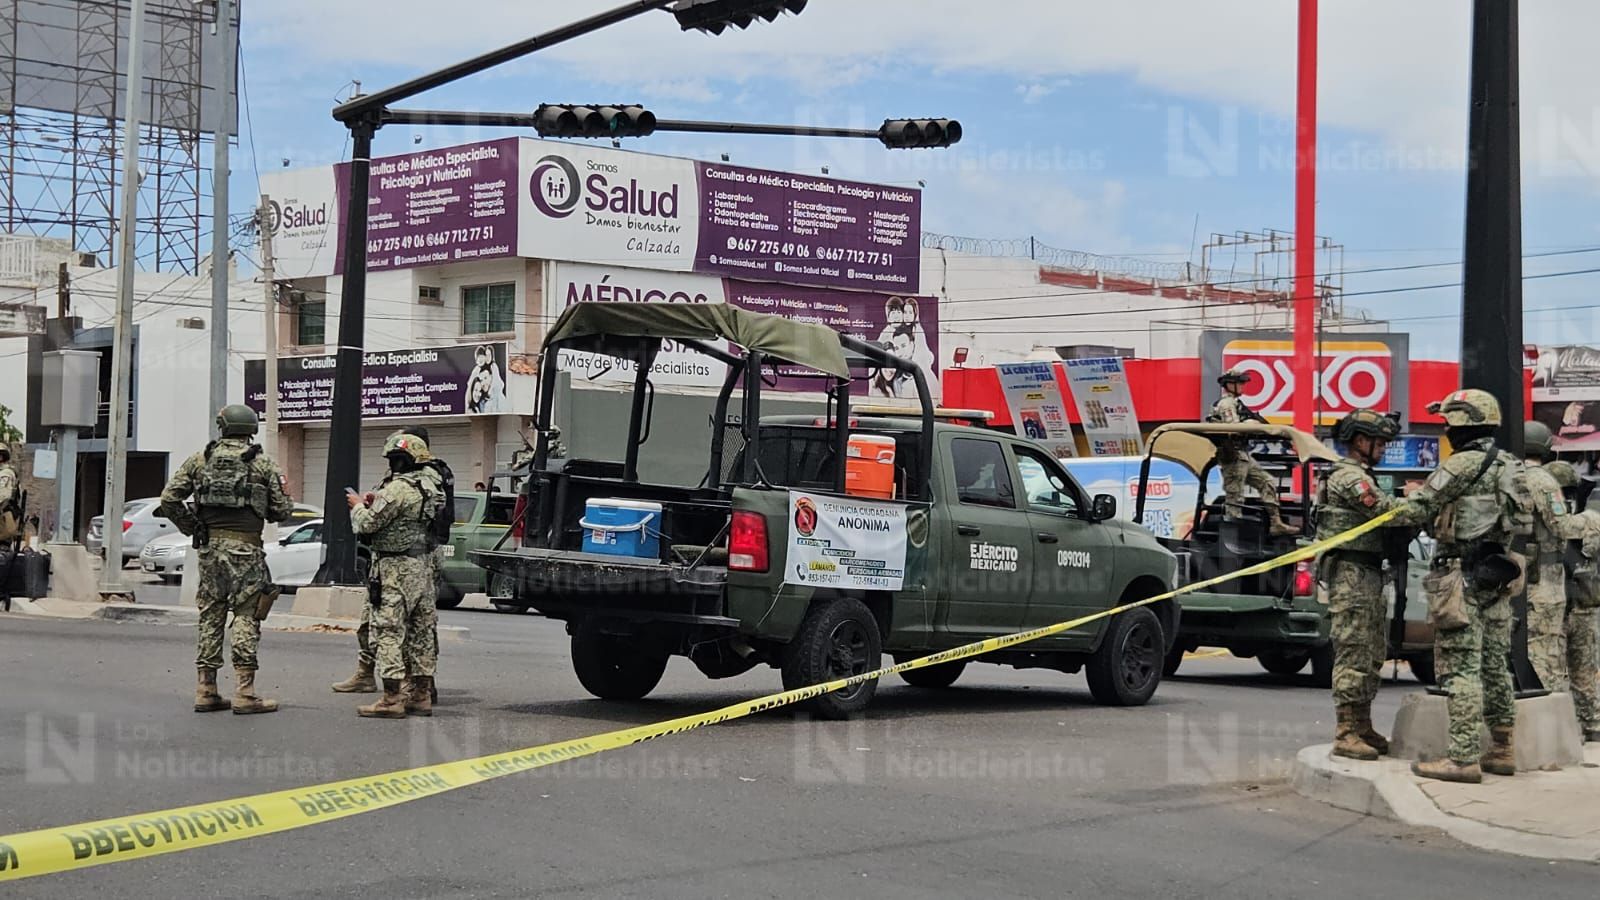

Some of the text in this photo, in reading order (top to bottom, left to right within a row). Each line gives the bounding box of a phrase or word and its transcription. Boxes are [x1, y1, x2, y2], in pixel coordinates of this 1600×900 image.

[397, 160, 410, 171] de
[411, 156, 444, 170] Médico
[446, 146, 499, 166] Especialista,
[586, 160, 618, 173] Somos
[380, 165, 472, 190] Psicología y Nutrición
[705, 168, 914, 203] Consultas de Médico Especialista, Psicología y Nutrición
[585, 174, 678, 219] Salud
[714, 190, 754, 203] Laboratorio
[714, 199, 738, 209] Dental
[283, 202, 325, 229] Salud
[714, 208, 769, 222] Odontopediatra
[793, 201, 847, 215] Ecocardiograma
[585, 211, 682, 235] Damos bienestar
[713, 216, 779, 232] Prueba de esfuerzo
[793, 209, 857, 224] Electrocardiograma
[873, 219, 907, 230] Ultrasonido
[434, 225, 493, 247] 667 712 77 51
[793, 226, 819, 236] Rayos X
[873, 227, 908, 239] Tomografía
[367, 234, 425, 253] 667 275 49 06
[626, 237, 681, 255] Calzada
[738, 239, 810, 258] 667 275 49 06
[872, 235, 903, 246] Patología
[826, 248, 893, 266] 667 712 77 51
[783, 263, 840, 277] Somos Salud Oficial
[742, 295, 807, 309] Psicología y Nutrición
[388, 350, 438, 367] Especialista
[564, 353, 710, 377] Más de 90 epecialistas
[424, 381, 458, 393] Completos
[1226, 354, 1388, 414] OXXO
[1130, 482, 1170, 497] BMBO
[838, 516, 890, 532] ANONIMA
[1143, 509, 1172, 525] EDIAS
[970, 541, 1019, 562] EJÉRCITO
[1057, 550, 1091, 568] 0890314
[970, 558, 1018, 572] MEXICANO
